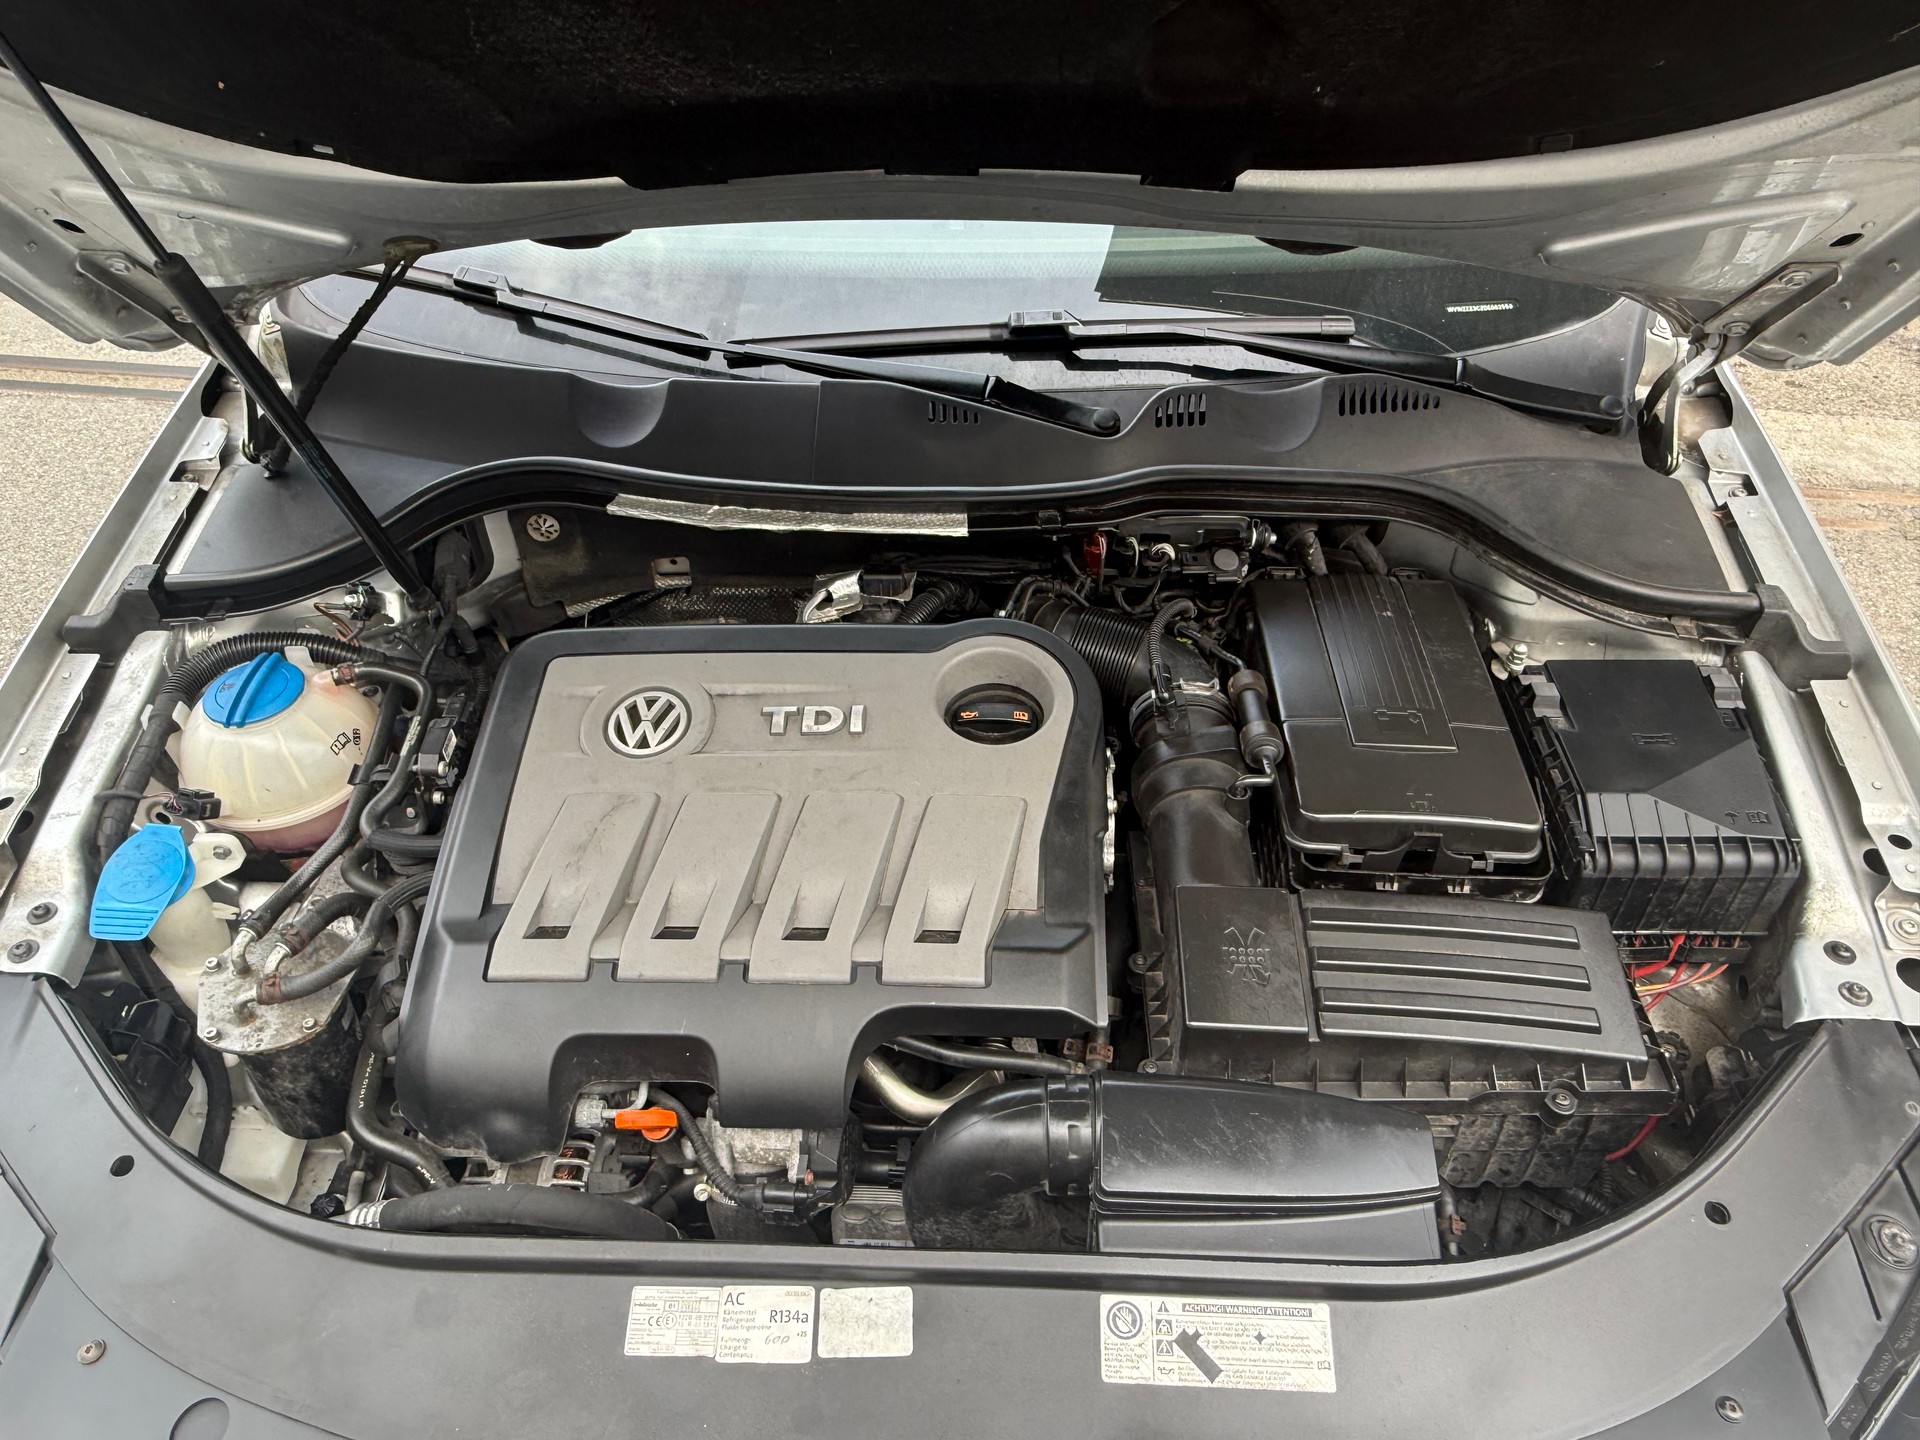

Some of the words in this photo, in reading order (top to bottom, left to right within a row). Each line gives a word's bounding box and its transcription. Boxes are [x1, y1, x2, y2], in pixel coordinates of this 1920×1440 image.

[762, 704, 866, 735] TDI
[723, 1292, 746, 1307] AC
[769, 1309, 809, 1324] R134a
[1184, 1304, 1224, 1314] ACHTUNG!
[1225, 1306, 1265, 1316] WARNING!
[1266, 1308, 1311, 1317] ATTENTION!
